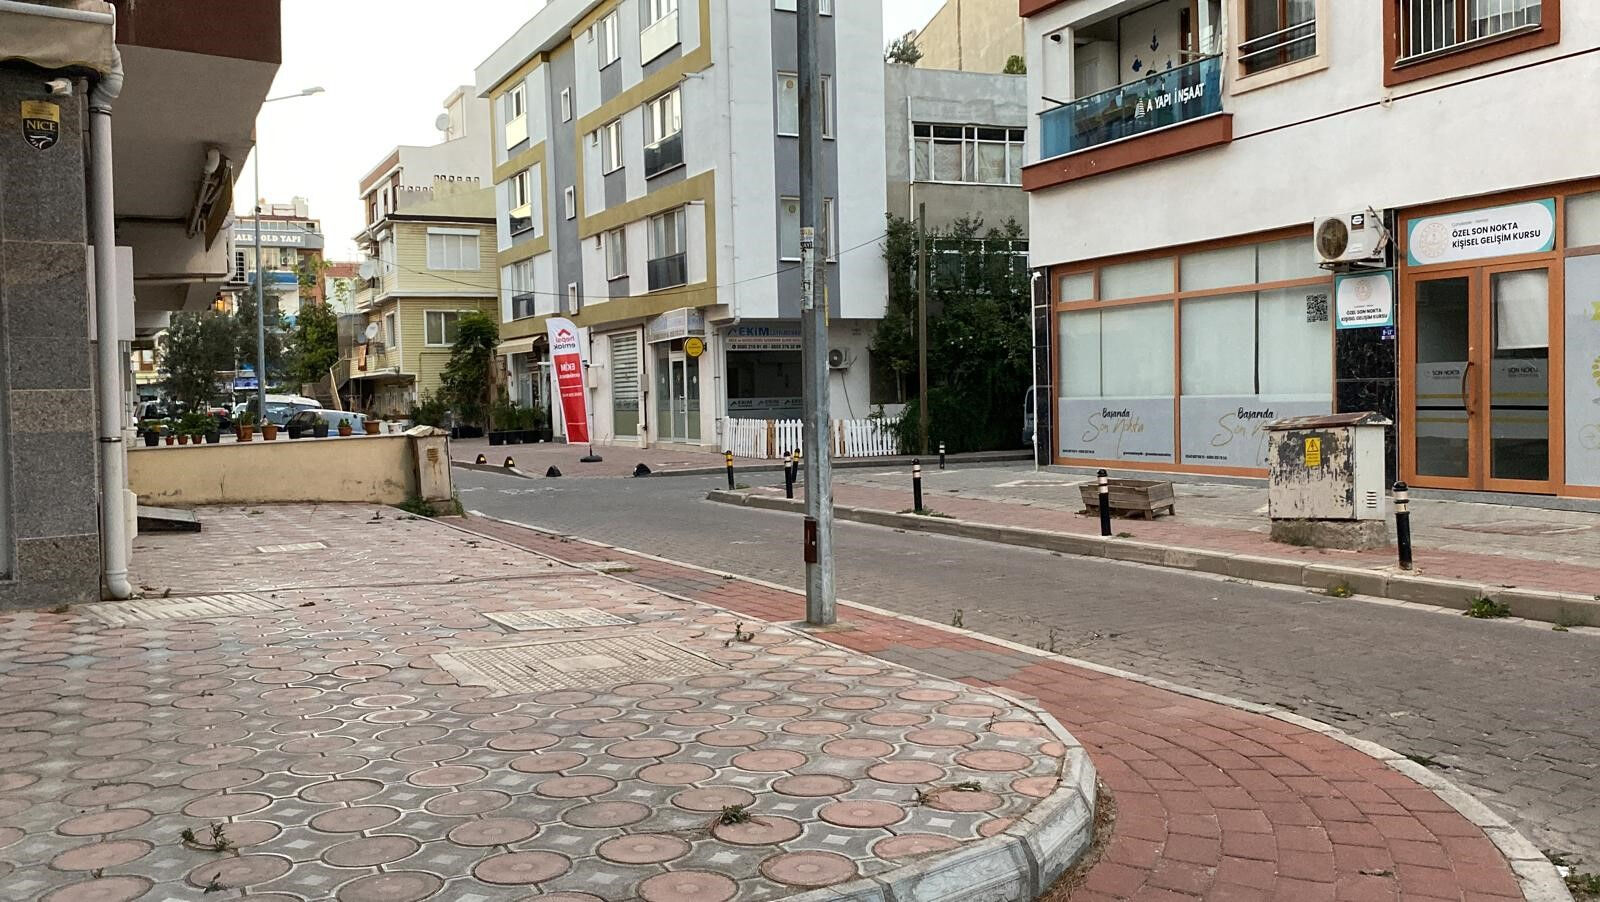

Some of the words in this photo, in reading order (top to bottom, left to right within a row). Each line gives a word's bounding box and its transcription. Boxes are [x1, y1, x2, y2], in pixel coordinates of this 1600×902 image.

[1146, 99, 1153, 112] A
[1154, 93, 1172, 109] YAPI
[1174, 83, 1205, 104] İNŞAAT
[26, 119, 56, 131] NICE
[1452, 228, 1470, 238] ÖZEL
[1471, 227, 1488, 235] SON
[1489, 222, 1518, 232] NOKTA
[1452, 238, 1479, 249] KİŞİSEL
[1480, 233, 1511, 245] GELİŞİM
[1512, 229, 1541, 241] KURSU
[1237, 407, 1274, 420] Başarıda
